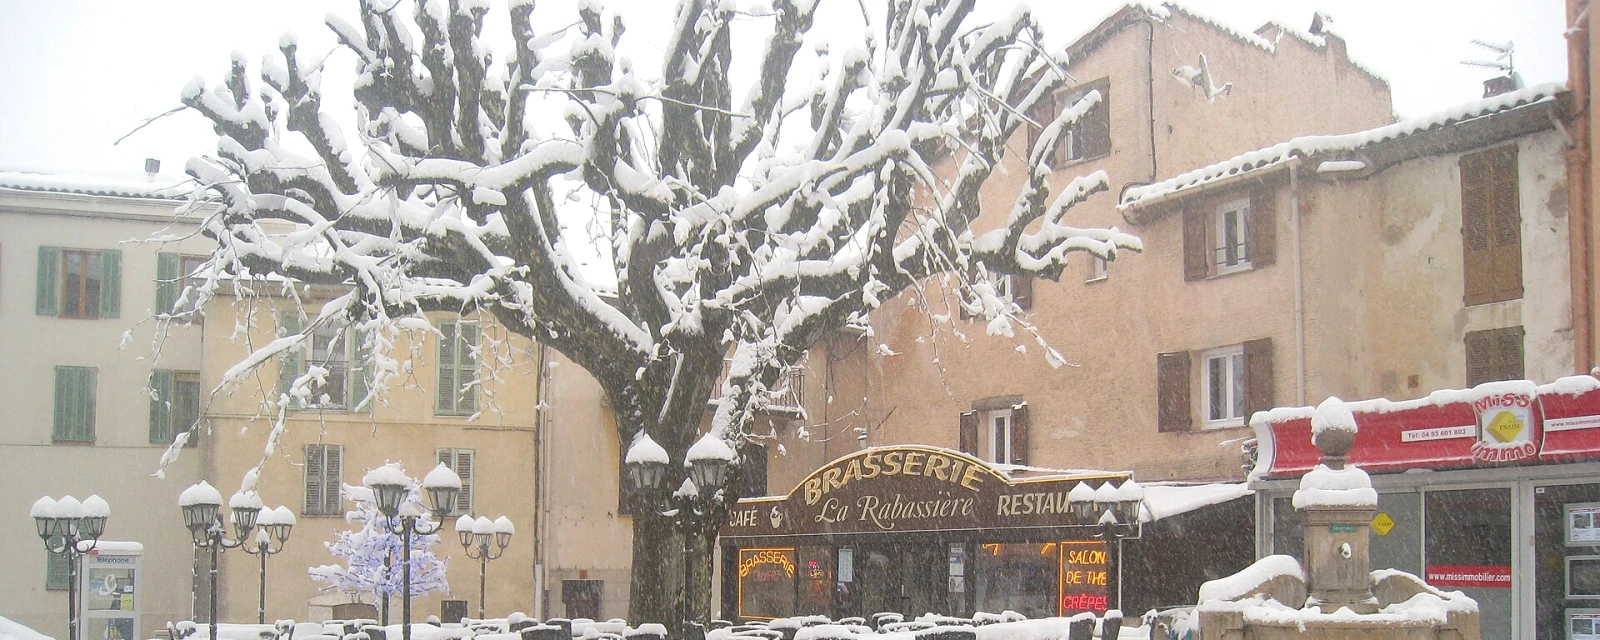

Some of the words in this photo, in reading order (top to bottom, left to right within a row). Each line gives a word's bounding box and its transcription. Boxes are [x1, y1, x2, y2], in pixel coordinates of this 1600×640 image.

[804, 451, 988, 506] BRASSERIE
[729, 505, 758, 527] CAFÉ
[814, 498, 849, 523] La
[856, 491, 974, 530] Rabassière
[96, 556, 129, 564] Téléphone
[740, 551, 795, 578] BRASSERIE
[1068, 550, 1106, 565] SALON
[1066, 571, 1082, 584] DE
[1429, 572, 1511, 582] www.missimmobilier.com
